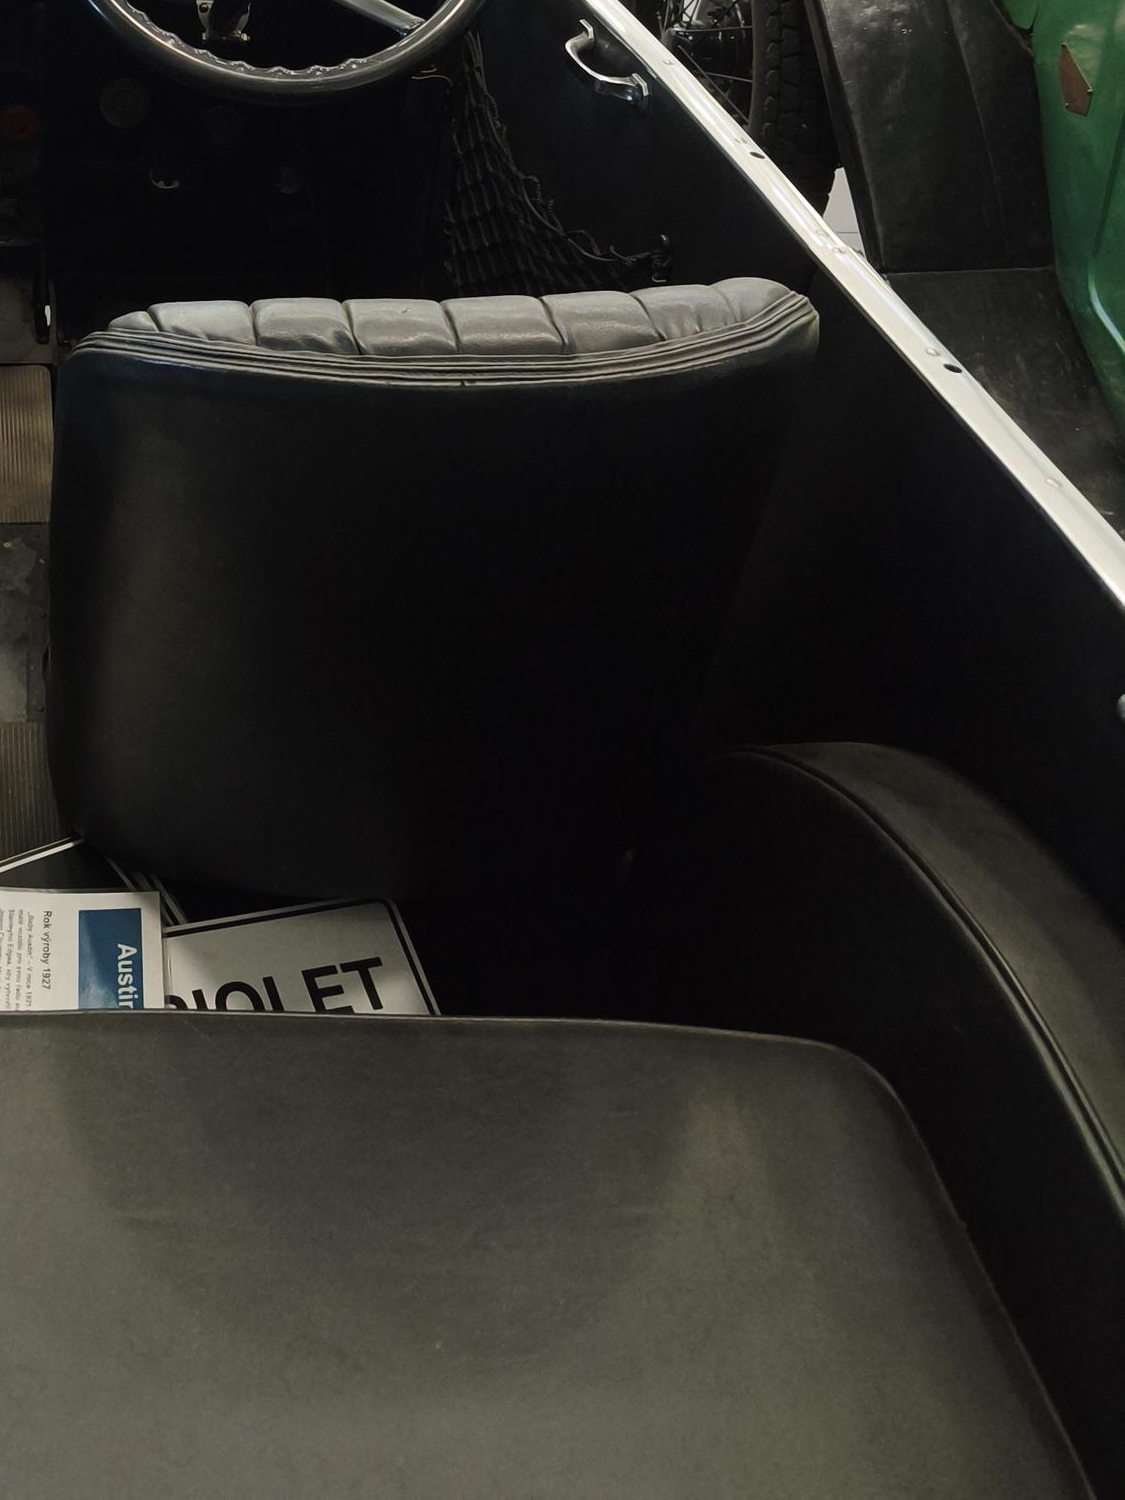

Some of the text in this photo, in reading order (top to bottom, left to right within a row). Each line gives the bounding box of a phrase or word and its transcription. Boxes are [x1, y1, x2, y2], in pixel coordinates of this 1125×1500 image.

[41, 910, 52, 990] Rok výroby 1927
